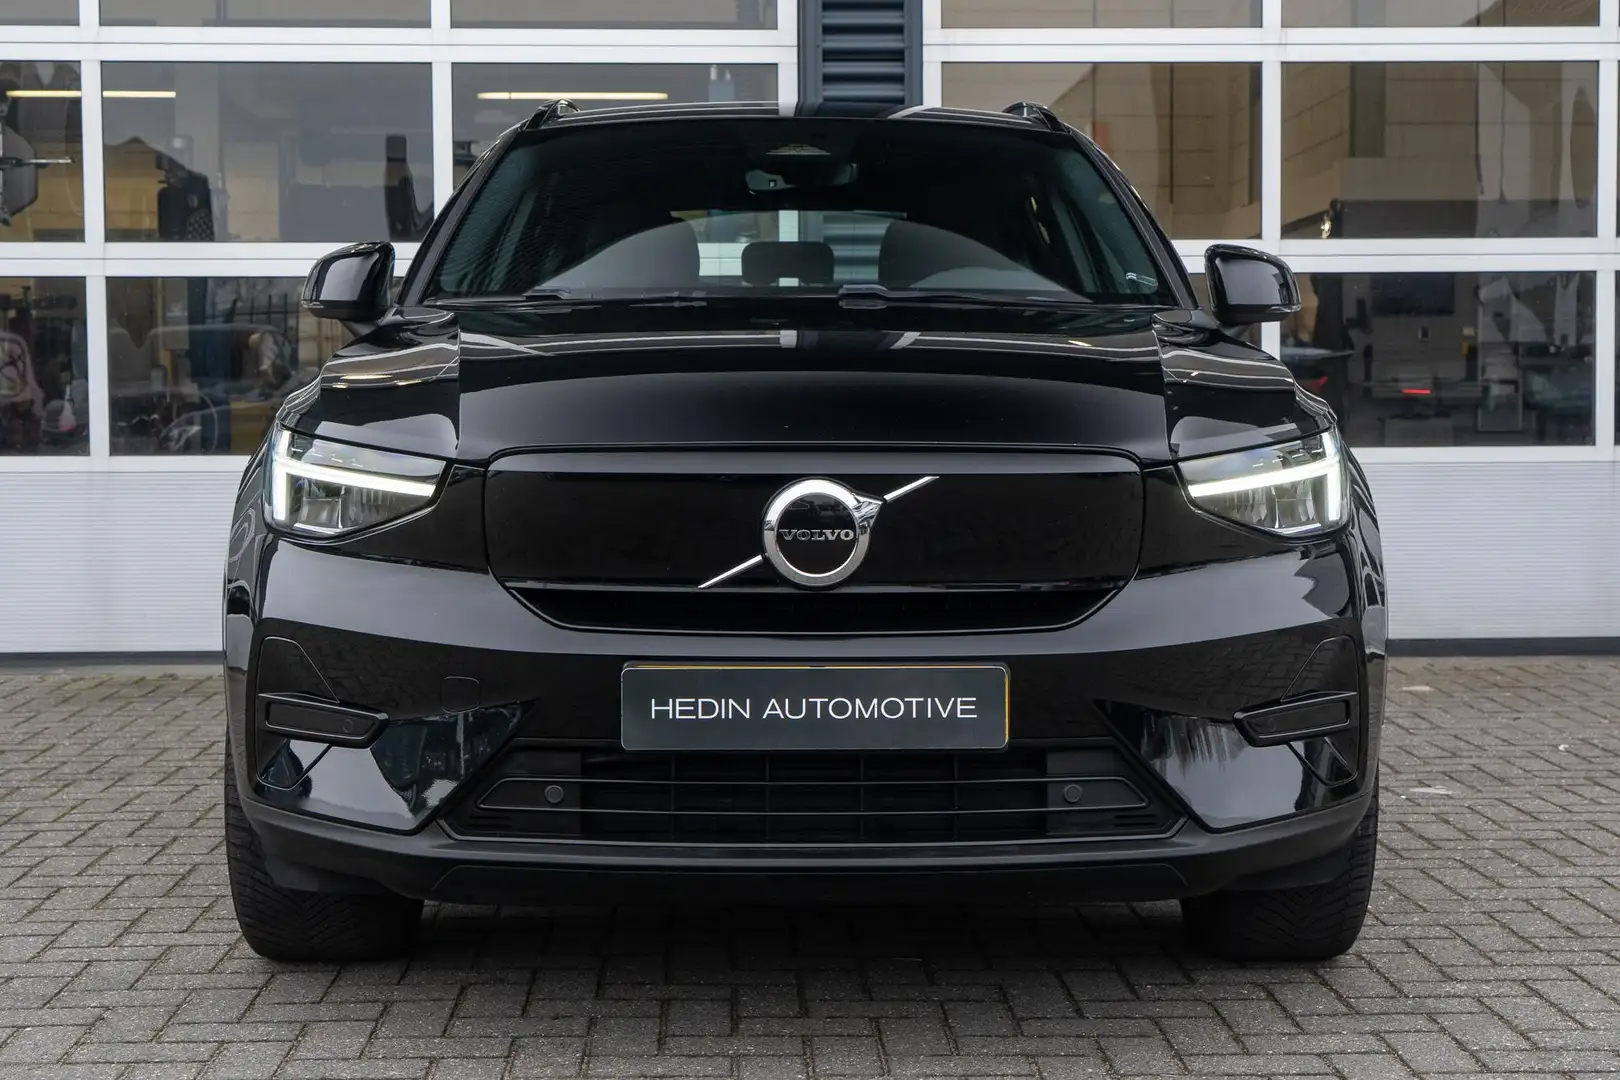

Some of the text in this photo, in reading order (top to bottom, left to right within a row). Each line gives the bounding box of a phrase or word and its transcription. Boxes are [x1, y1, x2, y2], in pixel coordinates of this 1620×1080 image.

[779, 529, 855, 541] VOLVO
[651, 697, 978, 720] HEDIN AUTOMOTIVE
